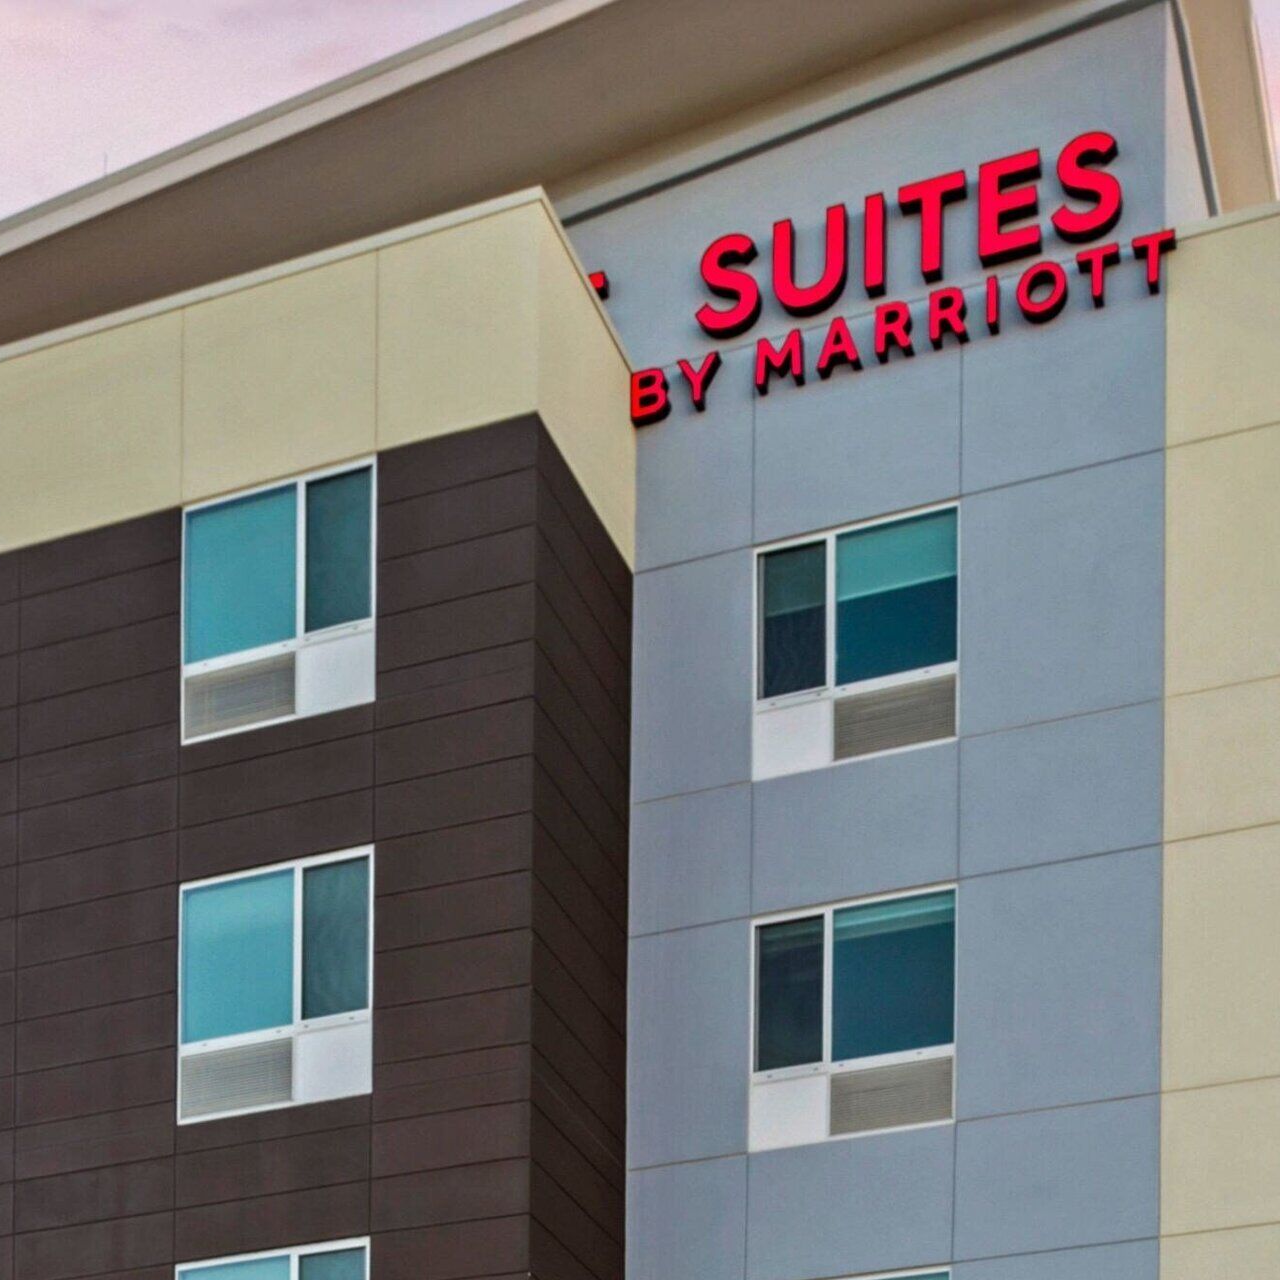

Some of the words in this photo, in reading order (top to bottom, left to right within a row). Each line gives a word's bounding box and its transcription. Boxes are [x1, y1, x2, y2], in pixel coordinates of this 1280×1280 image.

[630, 351, 721, 427] BY
[754, 229, 1176, 396] MARRIOTT
[695, 131, 1122, 338] SUITES
